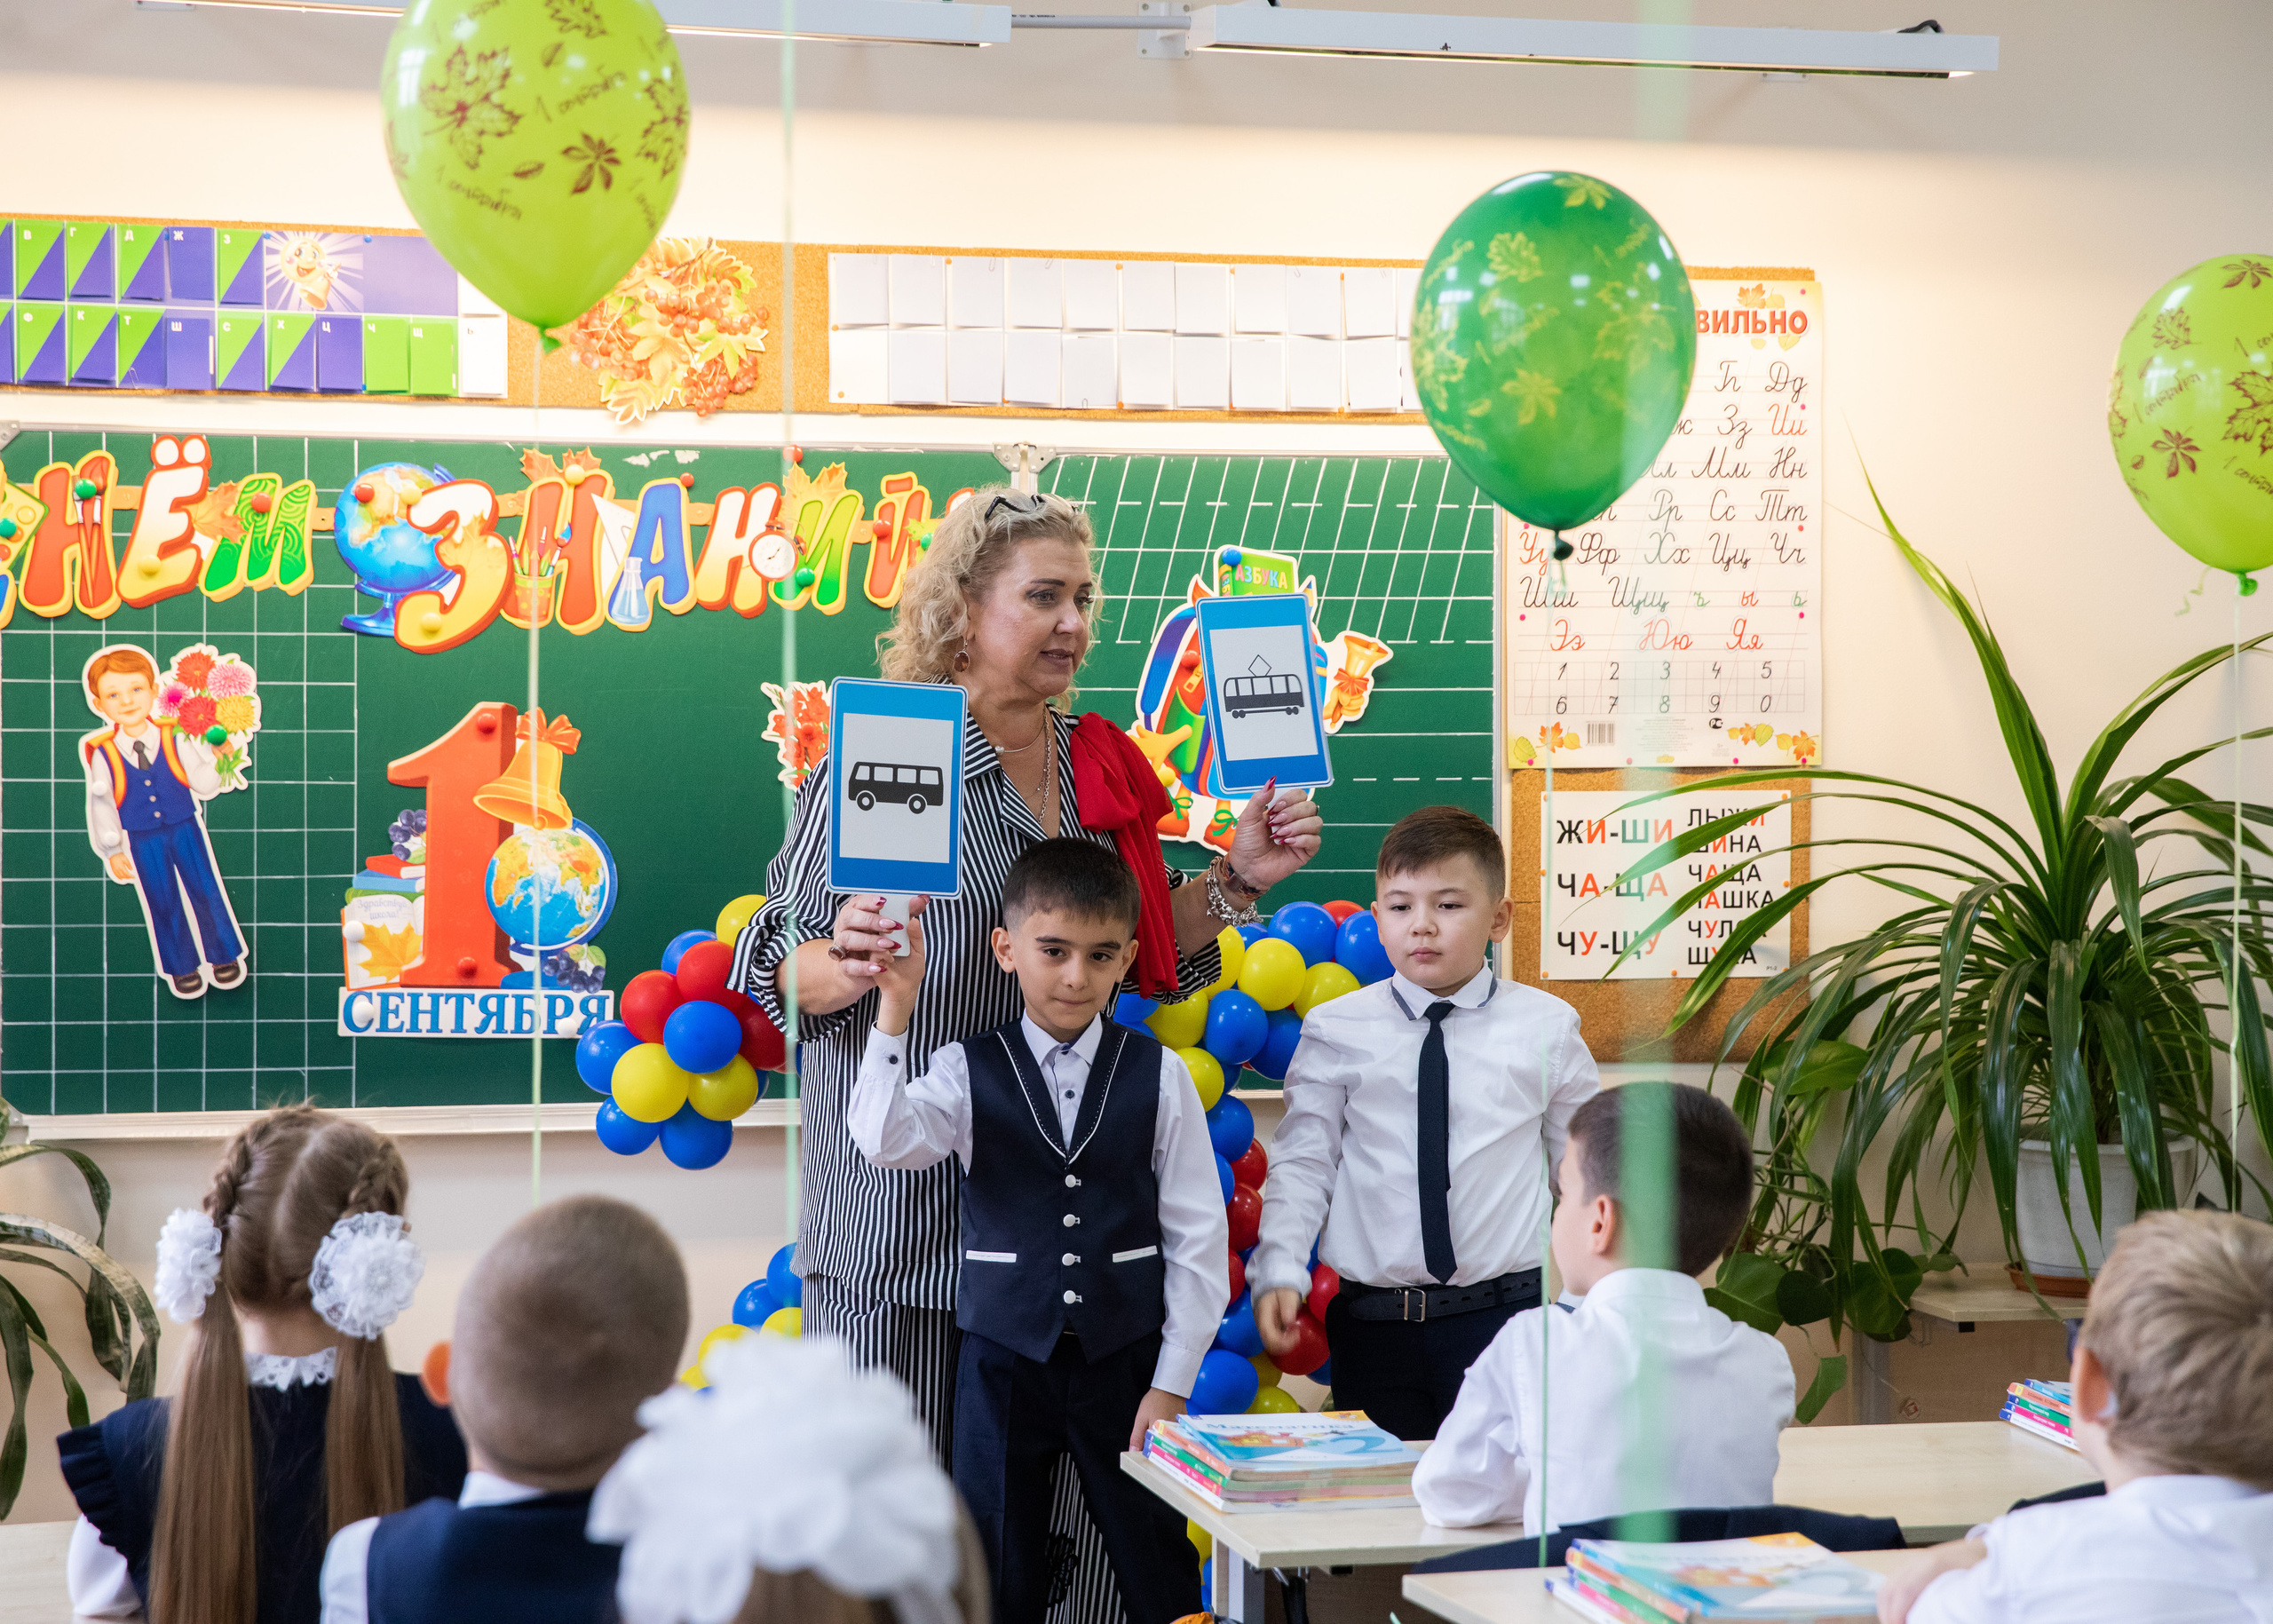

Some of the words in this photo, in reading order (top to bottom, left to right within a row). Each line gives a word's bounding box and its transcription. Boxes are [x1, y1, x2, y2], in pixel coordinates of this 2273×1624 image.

[23, 229, 32, 241] В
[69, 226, 77, 237] Г
[124, 229, 135, 242] Д
[173, 230, 184, 242] Ж
[23, 313, 34, 322] Ф
[77, 309, 85, 321] К
[123, 315, 131, 326] Т
[170, 321, 183, 332] Ш
[321, 321, 331, 333] Ц
[368, 323, 376, 333] Ч
[412, 327, 424, 338] Щ
[1695, 309, 1808, 334] ВИЛЬНО
[1765, 360, 1809, 403] Дд
[1717, 404, 1753, 449] Зз
[1691, 446, 1751, 478] Мм
[1770, 447, 1808, 479] Нн
[1649, 488, 1683, 533] Рр
[1710, 489, 1736, 521] Сс
[1755, 489, 1808, 521] Тт
[0, 435, 315, 629] НЁМ
[394, 470, 975, 655] ЗНАНИЙ
[1577, 533, 1620, 576] Фф
[1644, 532, 1691, 564] Хх
[1709, 533, 1752, 572] Цц
[1770, 533, 1806, 564] Чч
[1235, 563, 1288, 590] АЗБУКА
[1520, 576, 1579, 607] Шш
[1608, 576, 1669, 614] Щщ
[1550, 619, 1586, 651] Ээ
[1638, 619, 1693, 651] Юю
[1726, 618, 1763, 650] Яя
[1558, 662, 1567, 680] 1
[1610, 661, 1620, 680] 2
[1660, 661, 1671, 680] 3
[1712, 661, 1722, 679] 4
[1762, 661, 1772, 679] 5
[1556, 696, 1568, 715] 6
[1608, 696, 1619, 714] 7
[1659, 695, 1670, 714] 8
[1709, 695, 1720, 713] 9
[1760, 695, 1771, 713] 0
[387, 701, 520, 988] 1
[1556, 819, 1673, 844] ЖИ-ШИ
[1557, 873, 1668, 901] ЧА-ЩА
[1698, 891, 1774, 909] АШКА
[1688, 920, 1767, 939] ЧУЛ
[1557, 931, 1661, 960] ЧУ-ЩУ
[343, 991, 610, 1035] СЕНТЯБРЯ
